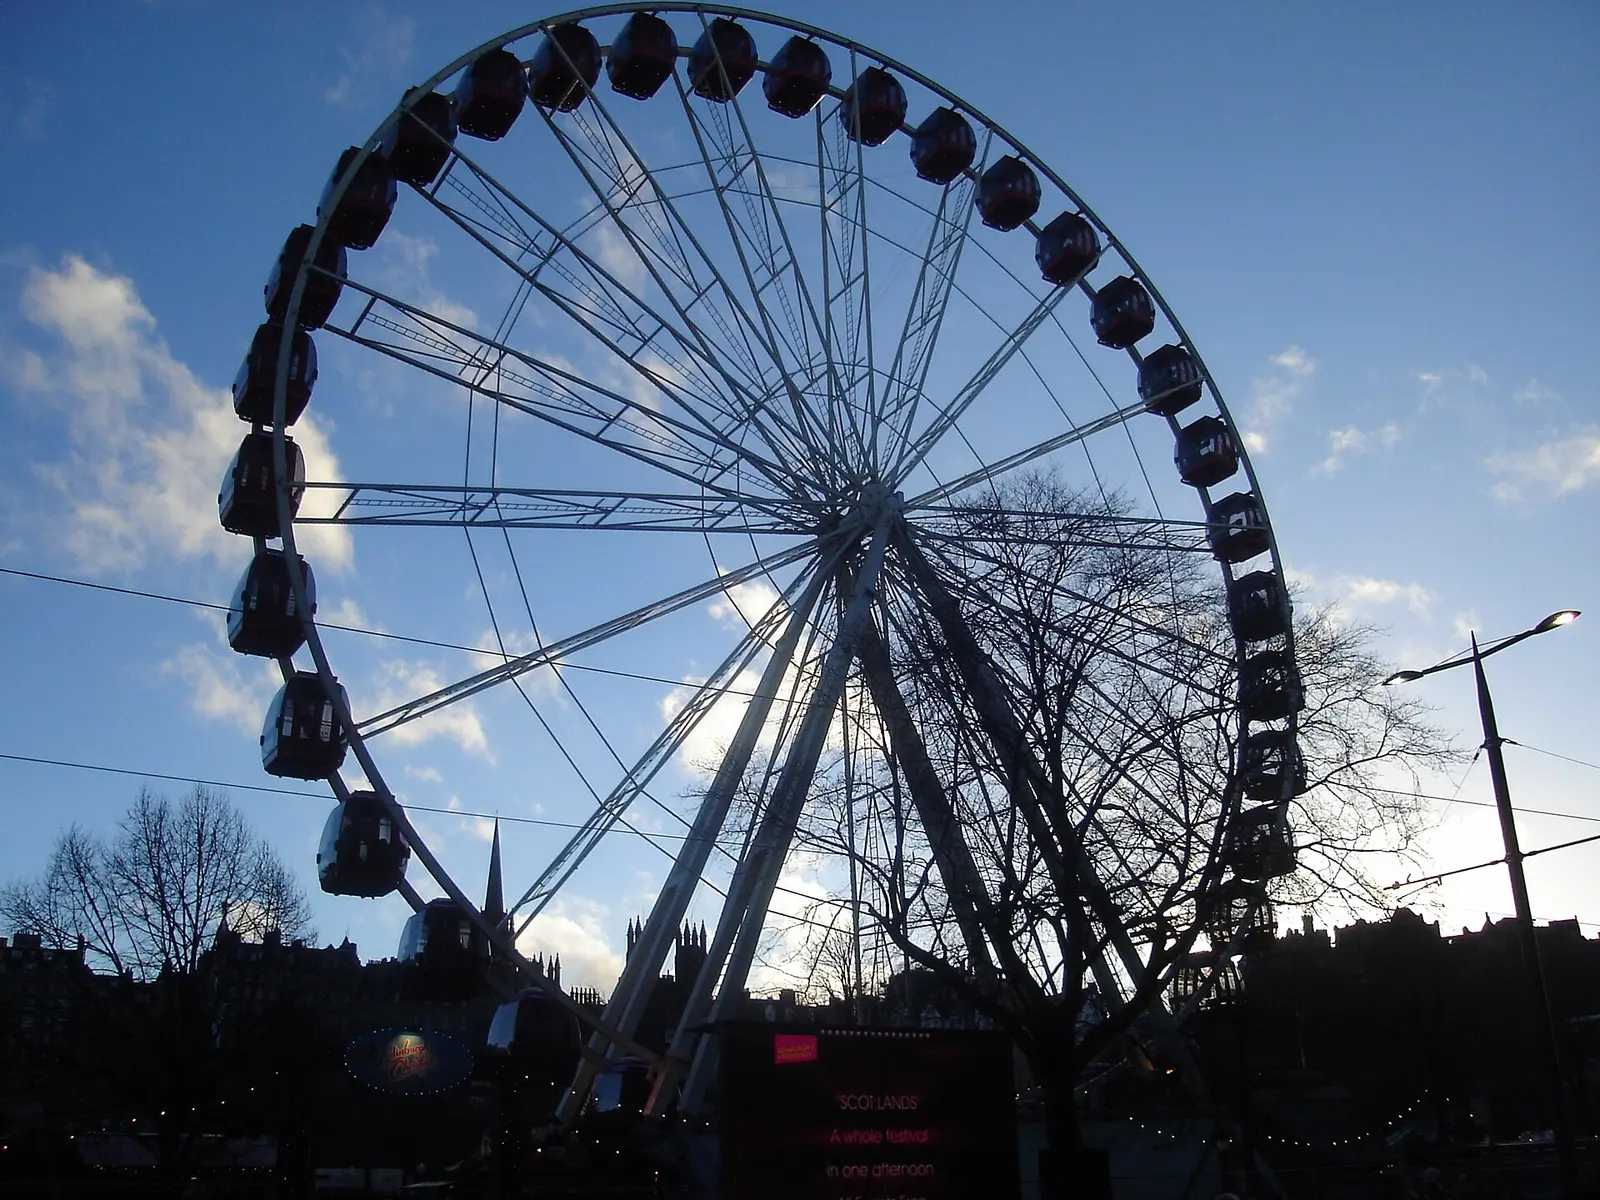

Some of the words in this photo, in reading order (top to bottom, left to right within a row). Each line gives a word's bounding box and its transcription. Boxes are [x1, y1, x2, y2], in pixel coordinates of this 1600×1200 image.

[829, 1128, 840, 1143] A
[843, 1127, 883, 1143] whole
[886, 1127, 928, 1143] festival
[827, 1161, 839, 1177] in
[841, 1164, 868, 1177] one
[871, 1161, 934, 1177] afternoon
